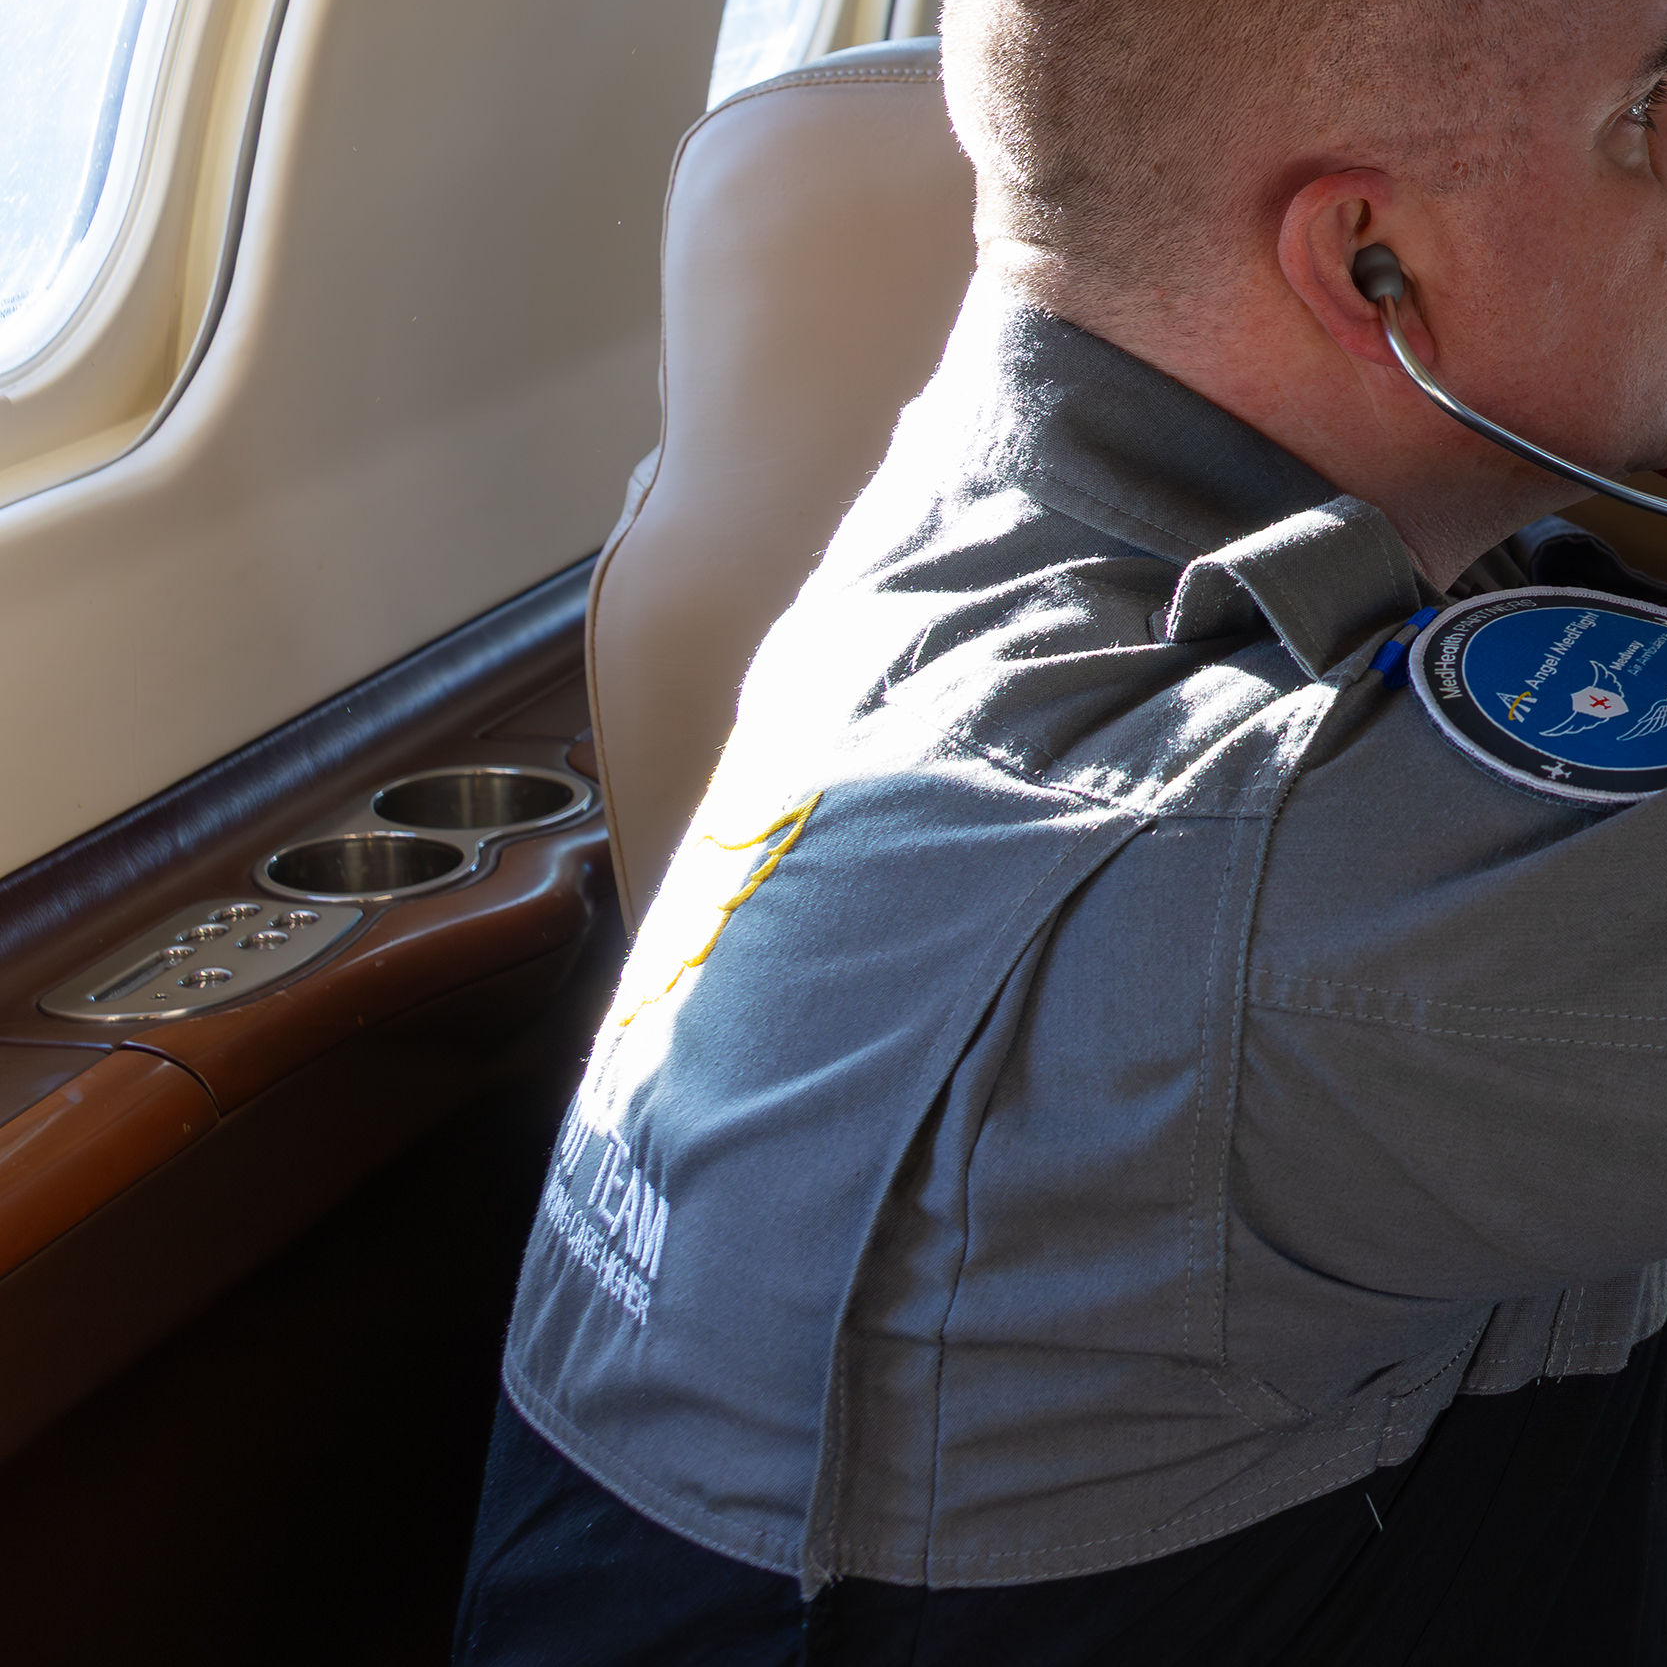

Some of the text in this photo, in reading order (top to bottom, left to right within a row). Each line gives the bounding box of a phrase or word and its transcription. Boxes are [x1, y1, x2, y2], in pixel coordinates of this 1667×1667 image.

[1434, 598, 1537, 700] MedHealth PARTNERS
[1524, 611, 1600, 690] Angel MedFlight
[1609, 639, 1644, 671] Medway
